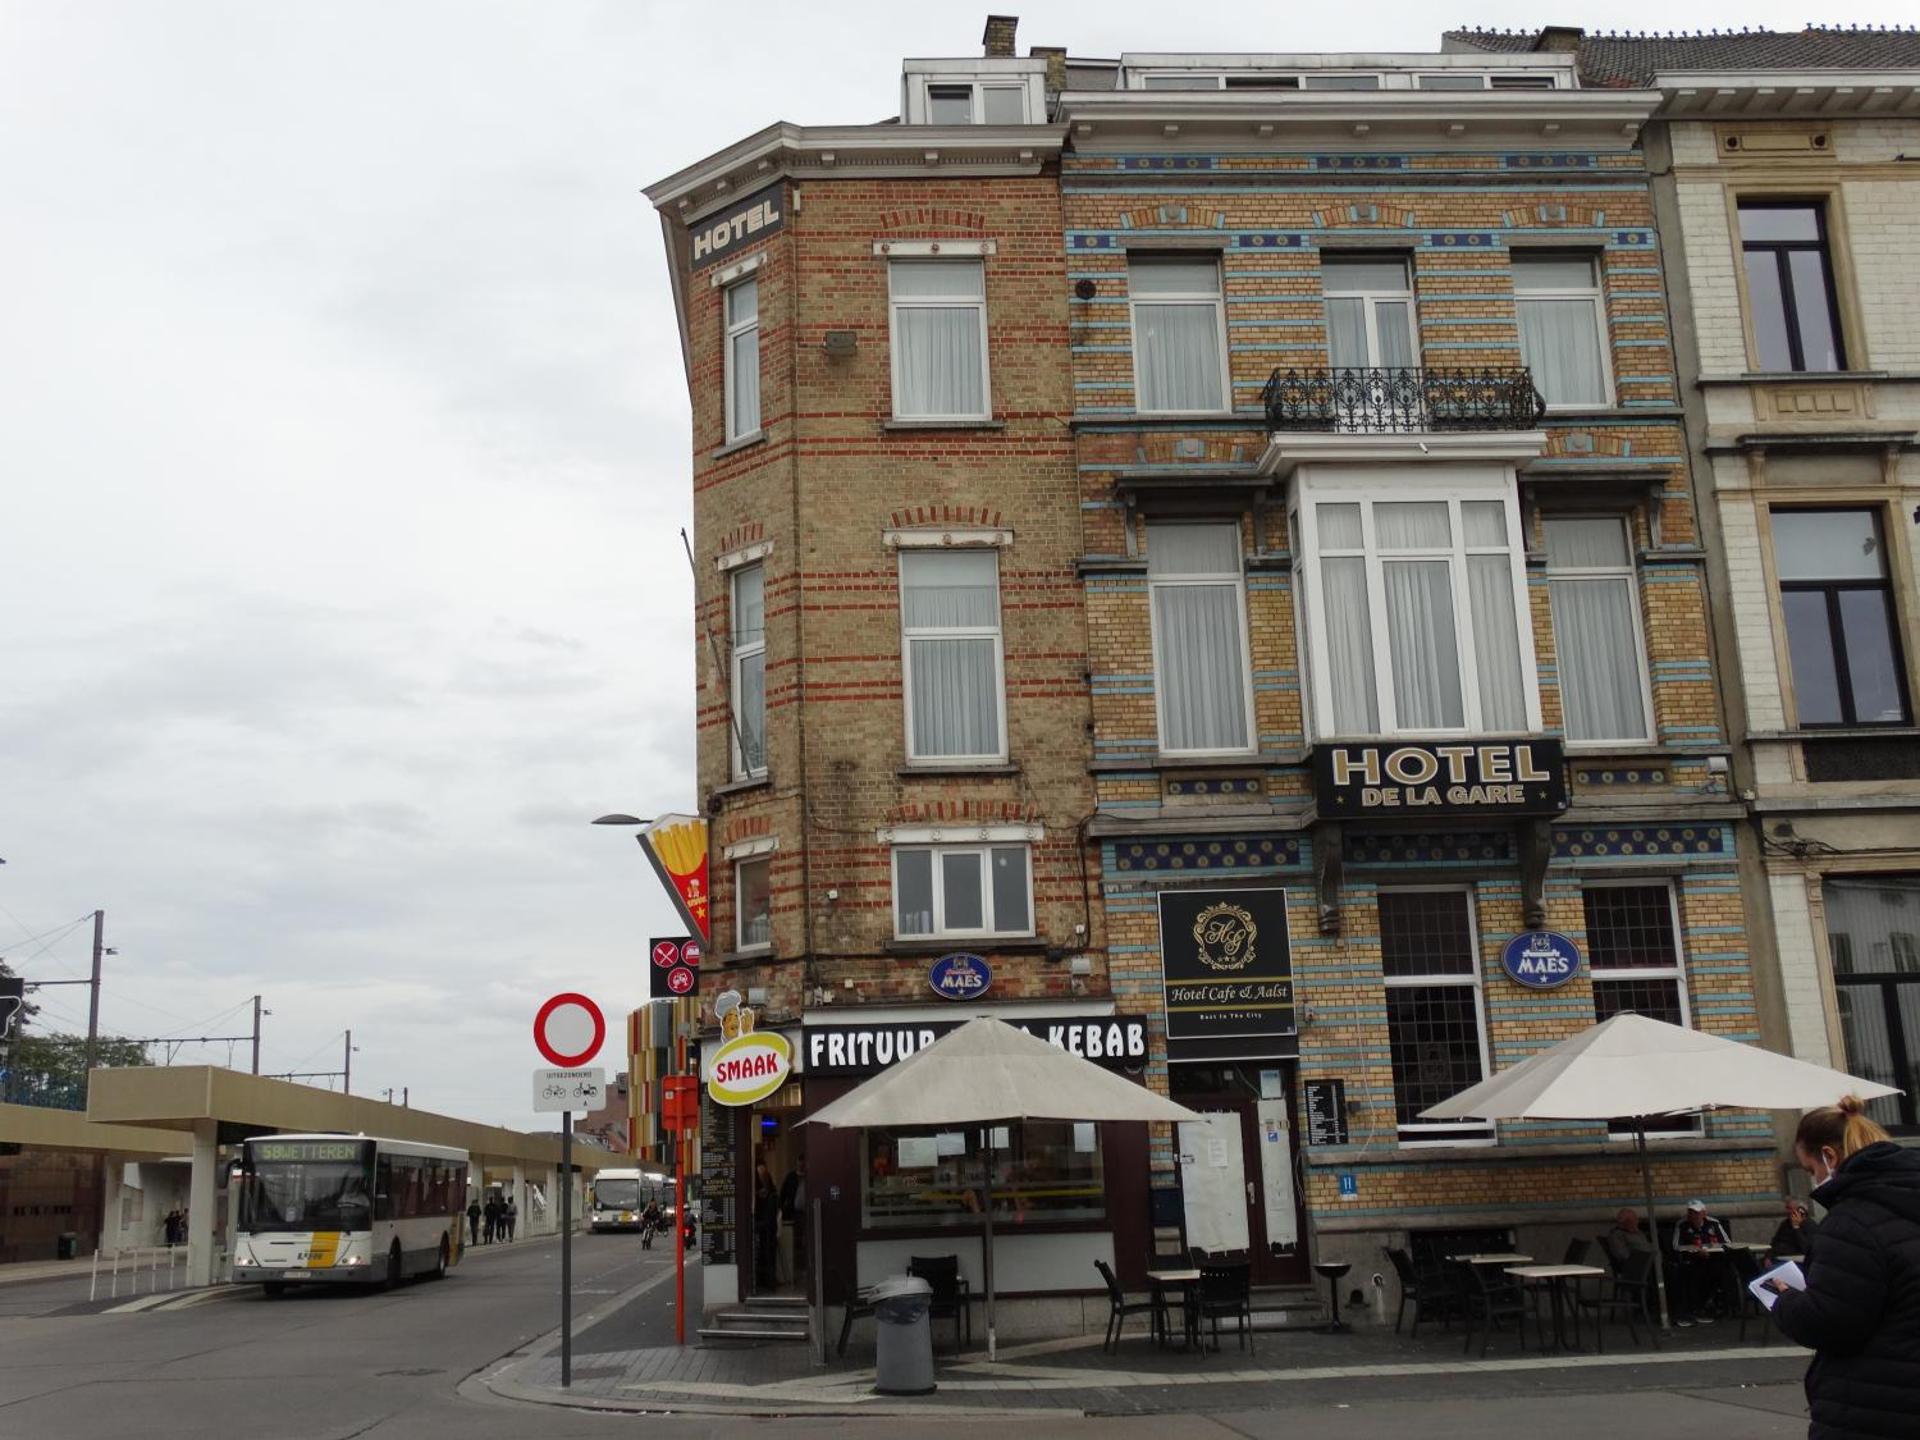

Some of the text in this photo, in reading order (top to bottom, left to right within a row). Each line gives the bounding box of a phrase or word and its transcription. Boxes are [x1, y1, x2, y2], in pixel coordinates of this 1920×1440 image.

[694, 199, 779, 261] HOTEL
[1332, 746, 1550, 786] HOTEL
[1361, 784, 1525, 807] DE LA GARE
[1517, 957, 1569, 974] MAES
[940, 974, 983, 988] MAES
[1171, 983, 1288, 1003] Hotel Cafe & Aalst
[1049, 1023, 1146, 1058] KEBAB
[716, 1052, 778, 1083] SMAAK
